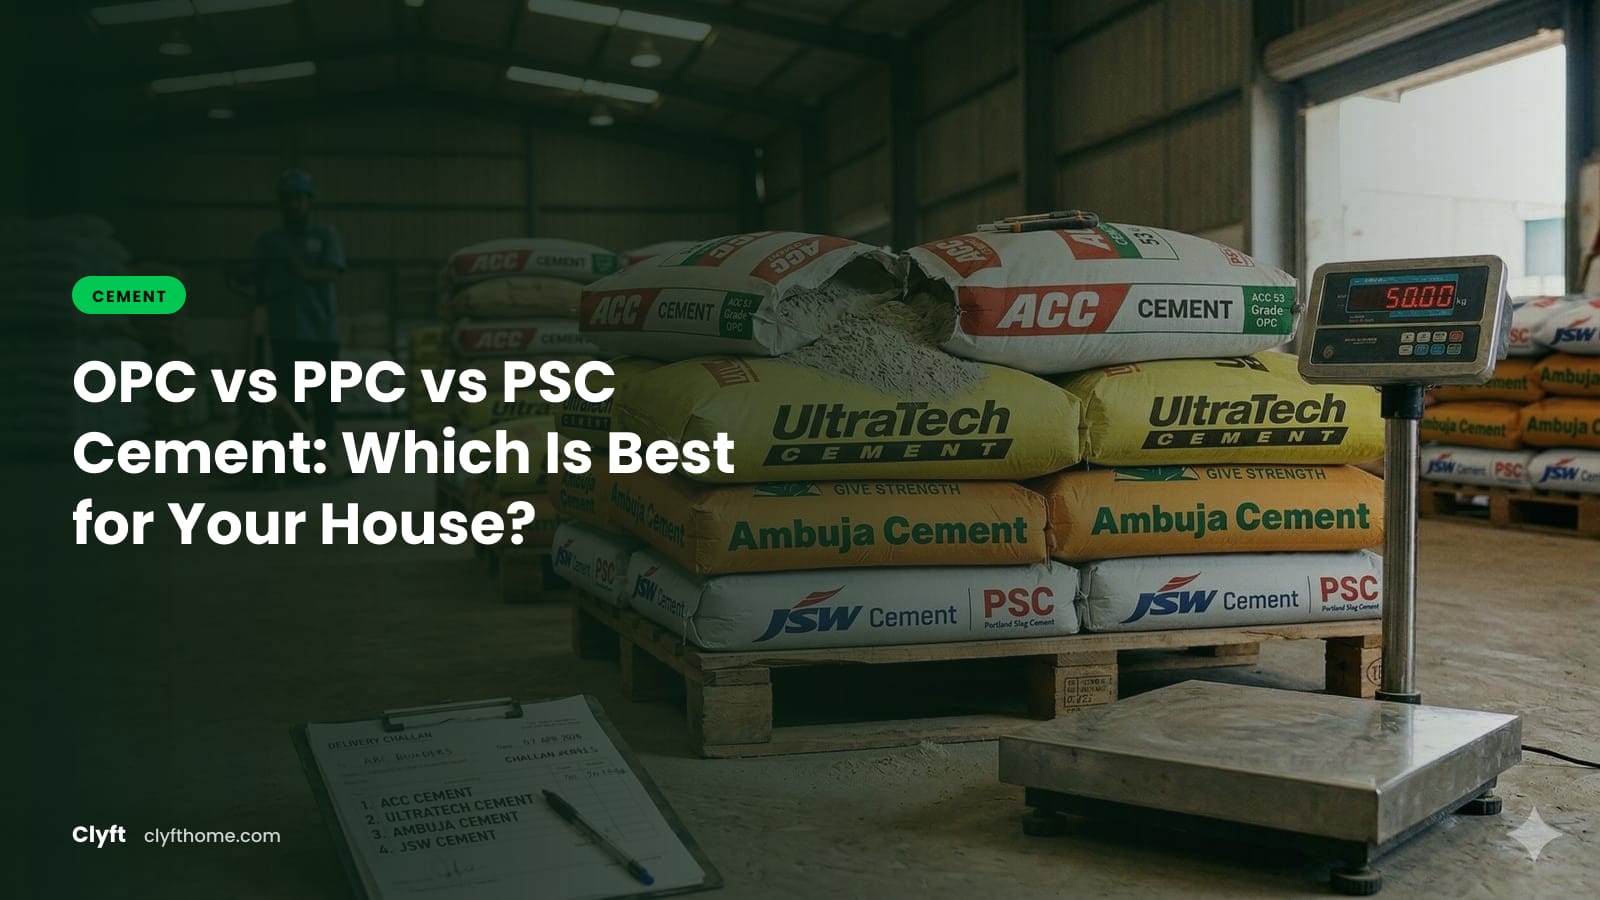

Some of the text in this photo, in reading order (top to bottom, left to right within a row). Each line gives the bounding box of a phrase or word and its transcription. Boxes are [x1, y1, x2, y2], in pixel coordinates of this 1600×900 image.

[470, 252, 519, 273] ACC
[536, 255, 586, 269] CEMENT
[1251, 293, 1285, 303] ACC 53
[1386, 285, 1455, 309] 50.00
[1456, 296, 1467, 306] kg
[590, 294, 715, 326] ACC CEMENT
[724, 309, 748, 320] Grade
[996, 290, 1234, 330] ACC CEMENT
[1251, 304, 1284, 317] Grade
[726, 322, 743, 333] OPC
[1256, 318, 1278, 328] OPC
[1510, 328, 1530, 343] SC
[1551, 327, 1596, 346] JSW
[772, 400, 1011, 440] UltraTech
[1149, 393, 1347, 427] UltraTech
[1527, 416, 1588, 438] Ambuja
[1156, 430, 1334, 446] CEMENT
[779, 442, 998, 463] CEMENT
[1206, 467, 1327, 481] GIVE STRENGTH
[1494, 461, 1522, 478] PSC
[1538, 465, 1580, 483] JSW
[833, 482, 961, 496] GIVE STRENGTH
[611, 482, 645, 523] Ambuja
[1092, 502, 1370, 538] Ambuja Cement
[728, 516, 1028, 553] Ambuja Cement
[595, 557, 616, 585] PSC
[1320, 575, 1378, 602] PSC
[983, 586, 1054, 618] PSC
[1119, 589, 1299, 625] JSW Cement
[751, 604, 957, 643] JSW Cement
[984, 618, 1055, 630] Portland Slag Cement
[328, 731, 433, 750] DELIVERY CHALLAN
[505, 751, 556, 764] CHALLAN
[380, 795, 410, 809] ACC
[414, 786, 473, 804] CEMENT
[365, 793, 534, 825] 2. ULTRATECH CEMENT
[372, 810, 519, 840] 3. AMBUJA CEMENT
[399, 838, 431, 853] JSW
[436, 829, 497, 848] CEMENT
